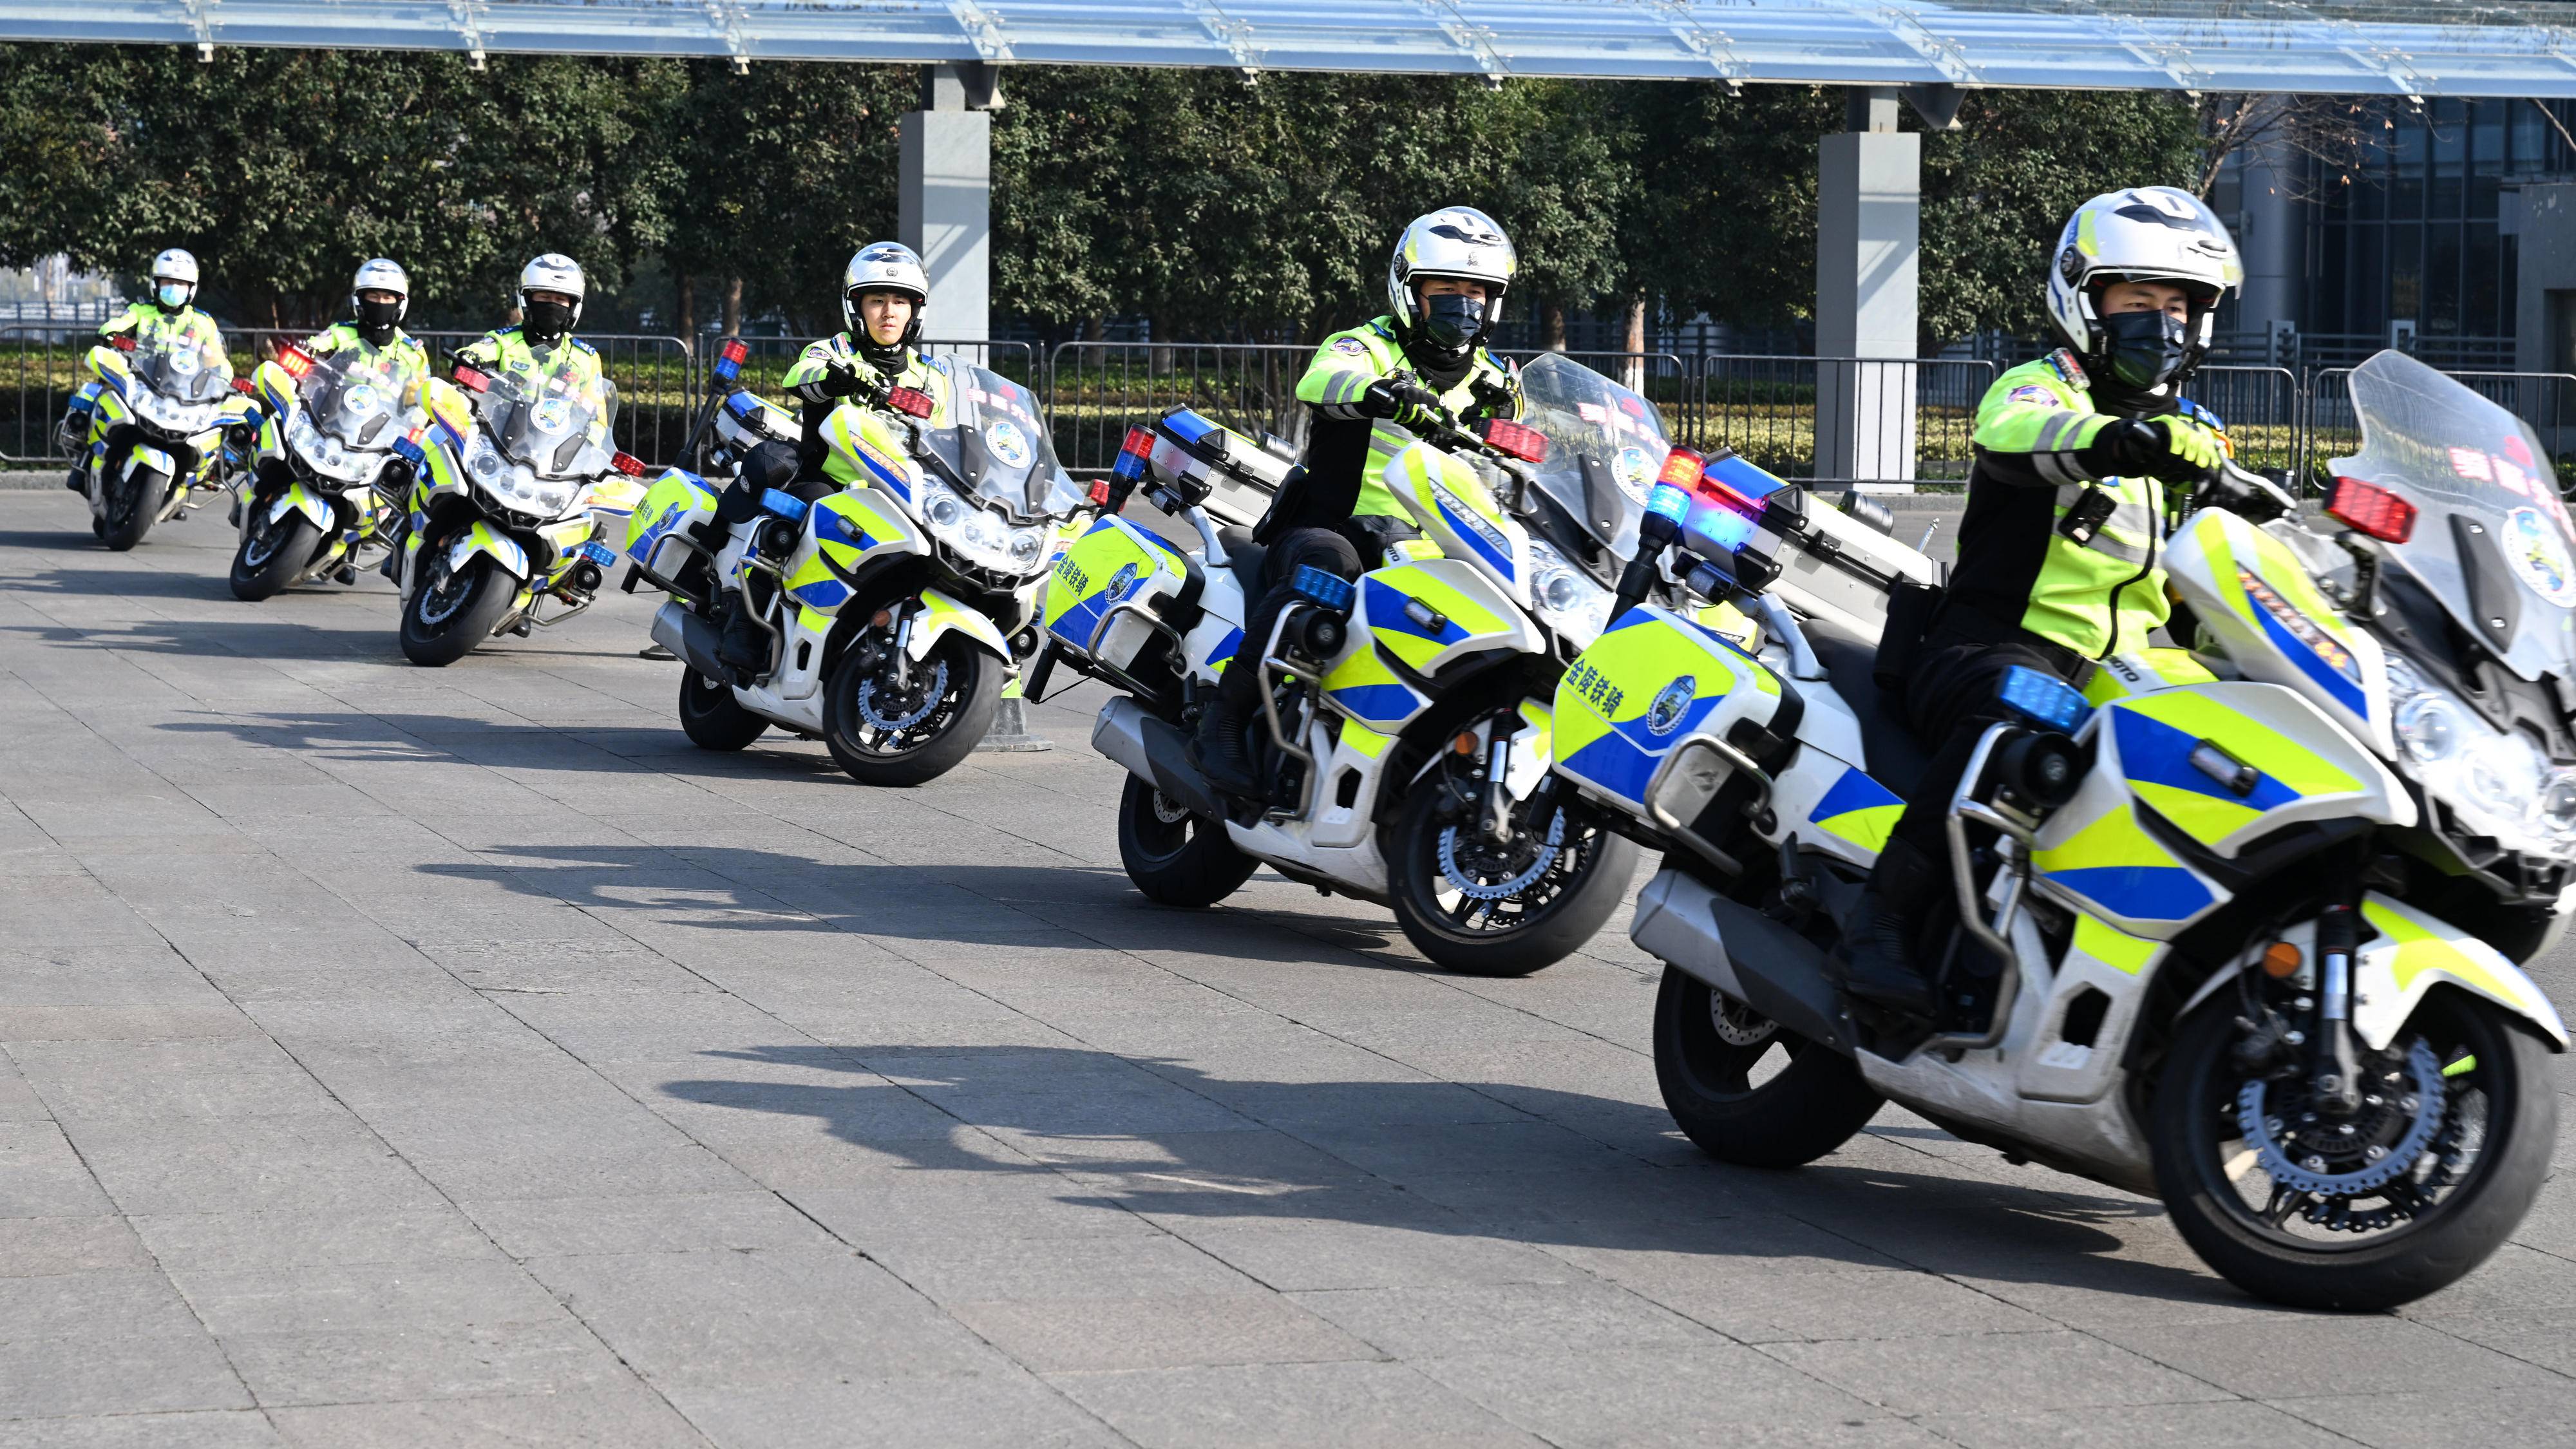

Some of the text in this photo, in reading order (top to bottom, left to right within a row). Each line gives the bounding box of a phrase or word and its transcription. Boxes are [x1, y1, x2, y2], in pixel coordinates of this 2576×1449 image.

[1057, 554, 1088, 596] 金陵铁骑
[1566, 658, 1624, 718] 金陵铁骑
